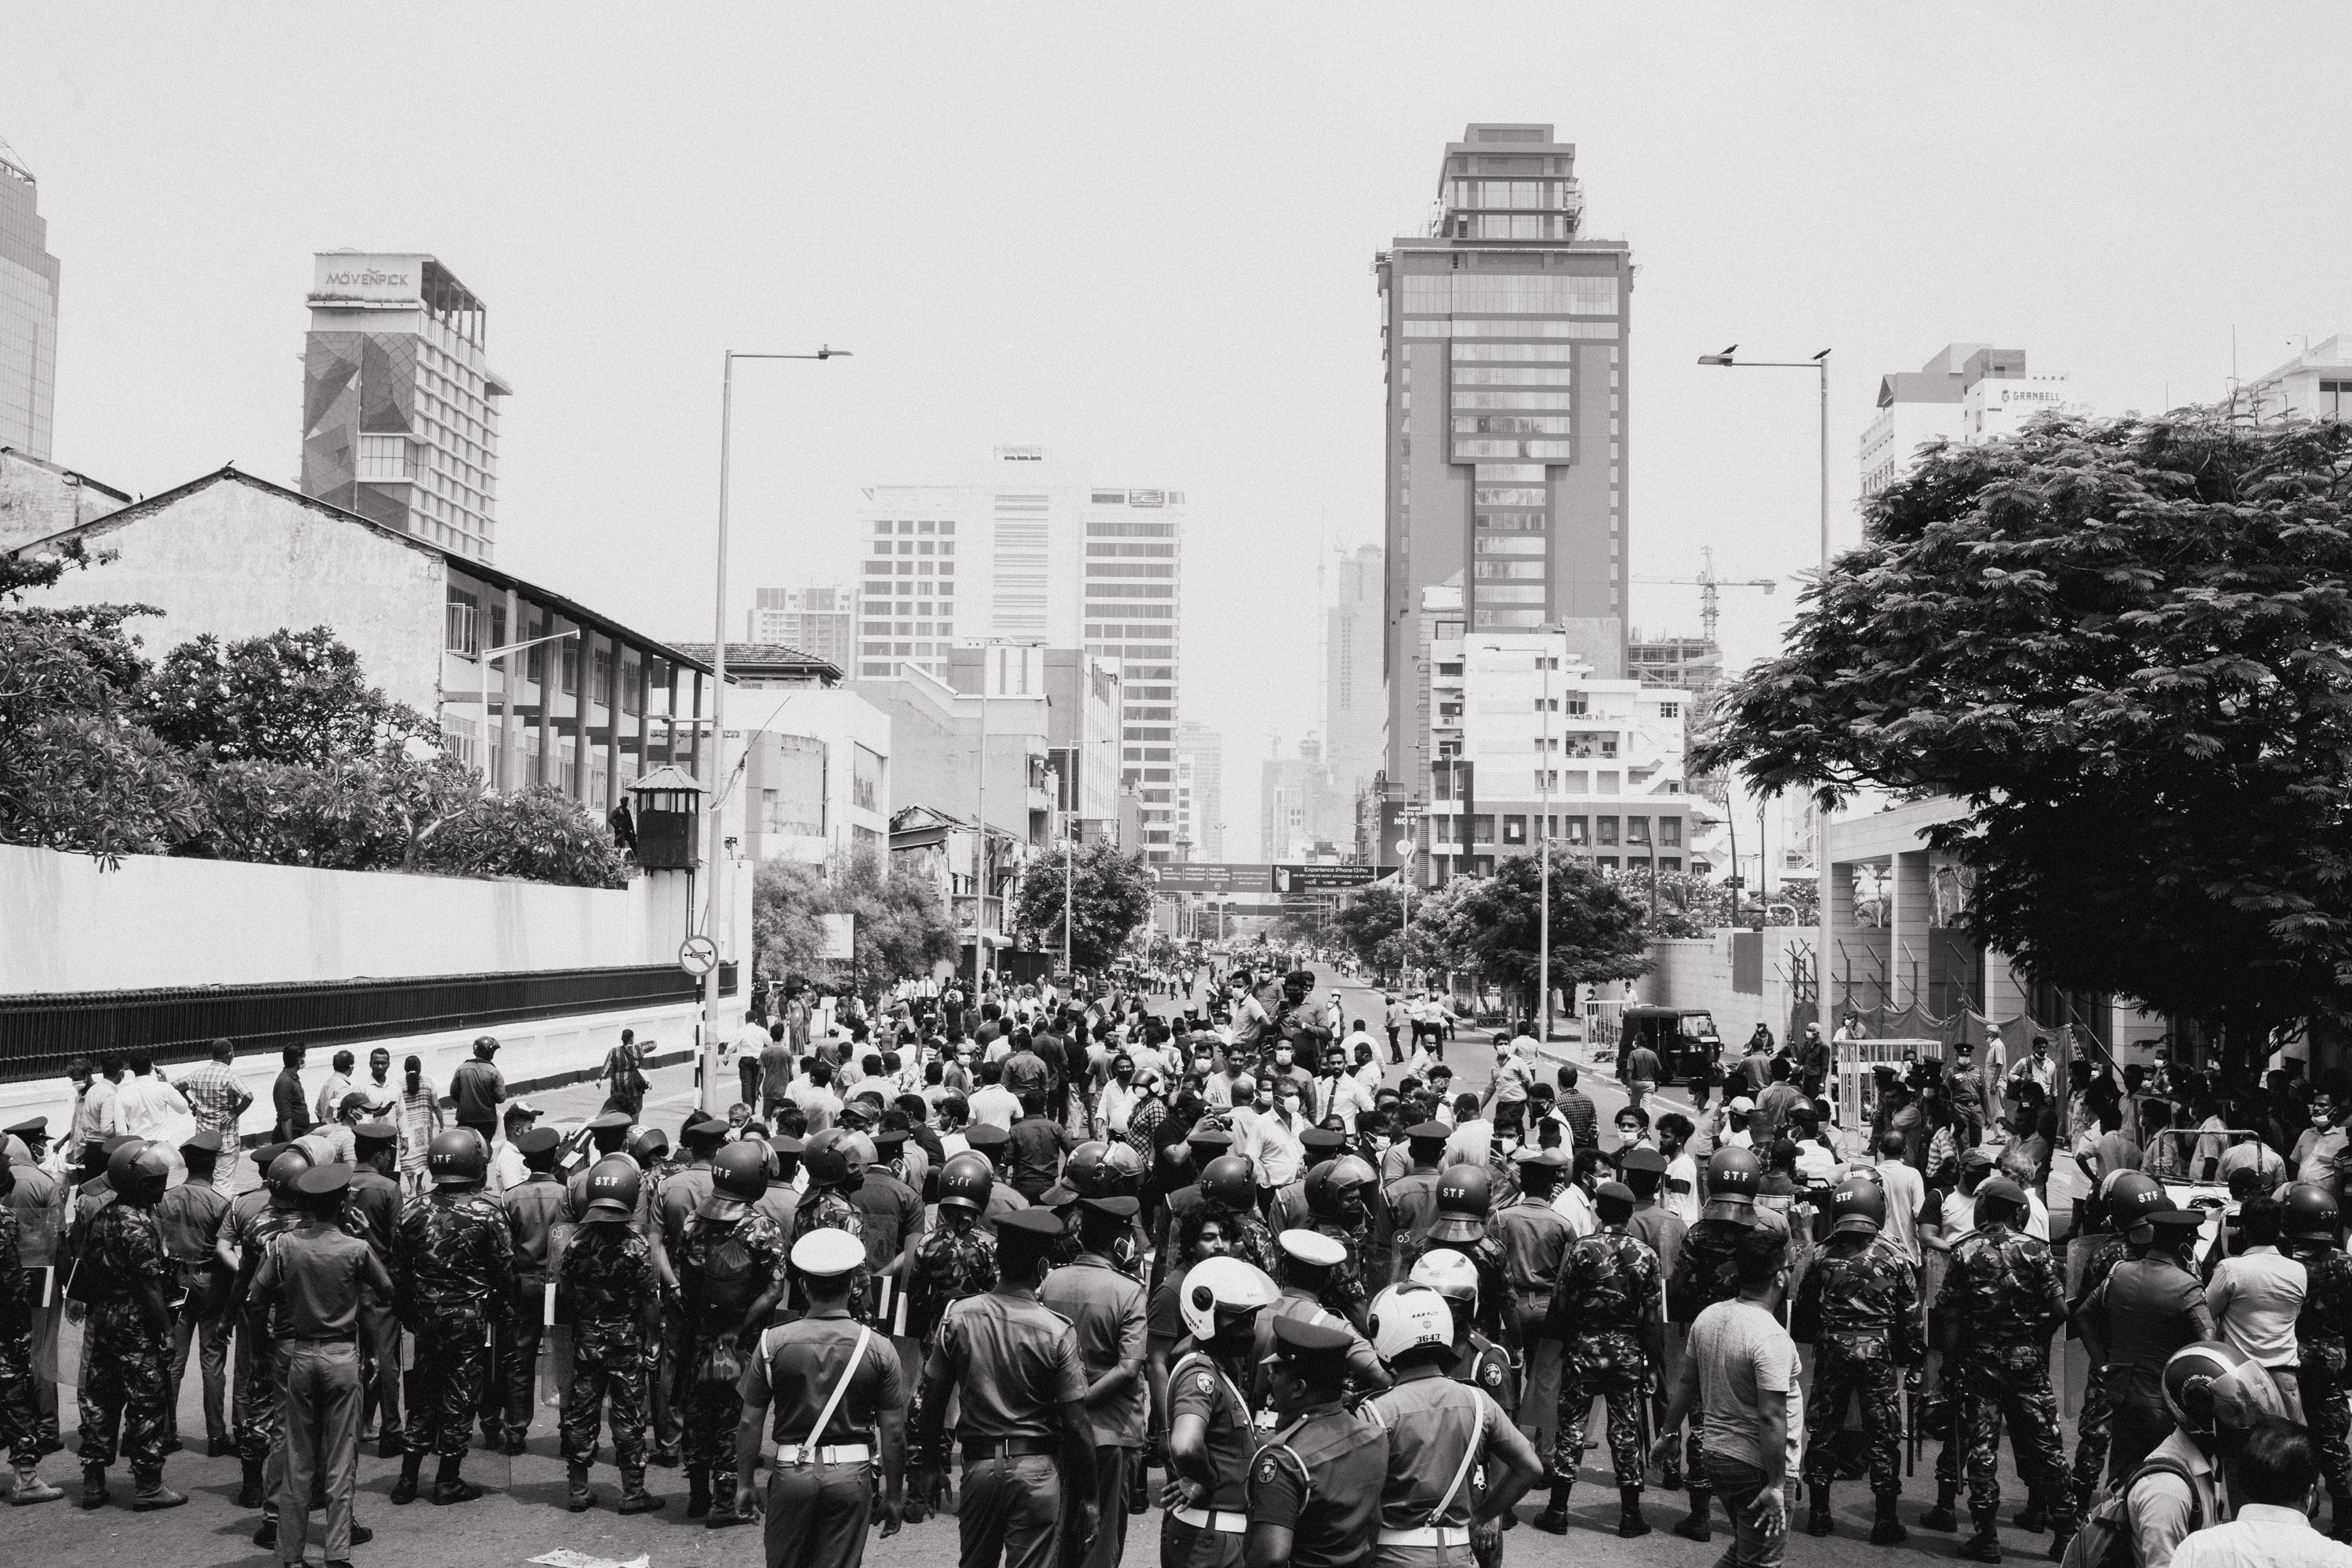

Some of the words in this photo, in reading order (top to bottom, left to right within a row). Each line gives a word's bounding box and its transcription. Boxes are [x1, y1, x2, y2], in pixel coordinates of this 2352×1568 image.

[326, 270, 408, 285] MÖVENPICK
[2013, 391, 2060, 401] GRANBELL
[594, 1176, 619, 1187] S.T.F
[2137, 1189, 2158, 1203] S.T.F
[1397, 1231, 1410, 1243] 05
[1791, 1243, 1803, 1255] 05
[1415, 1334, 1441, 1344] 3643
